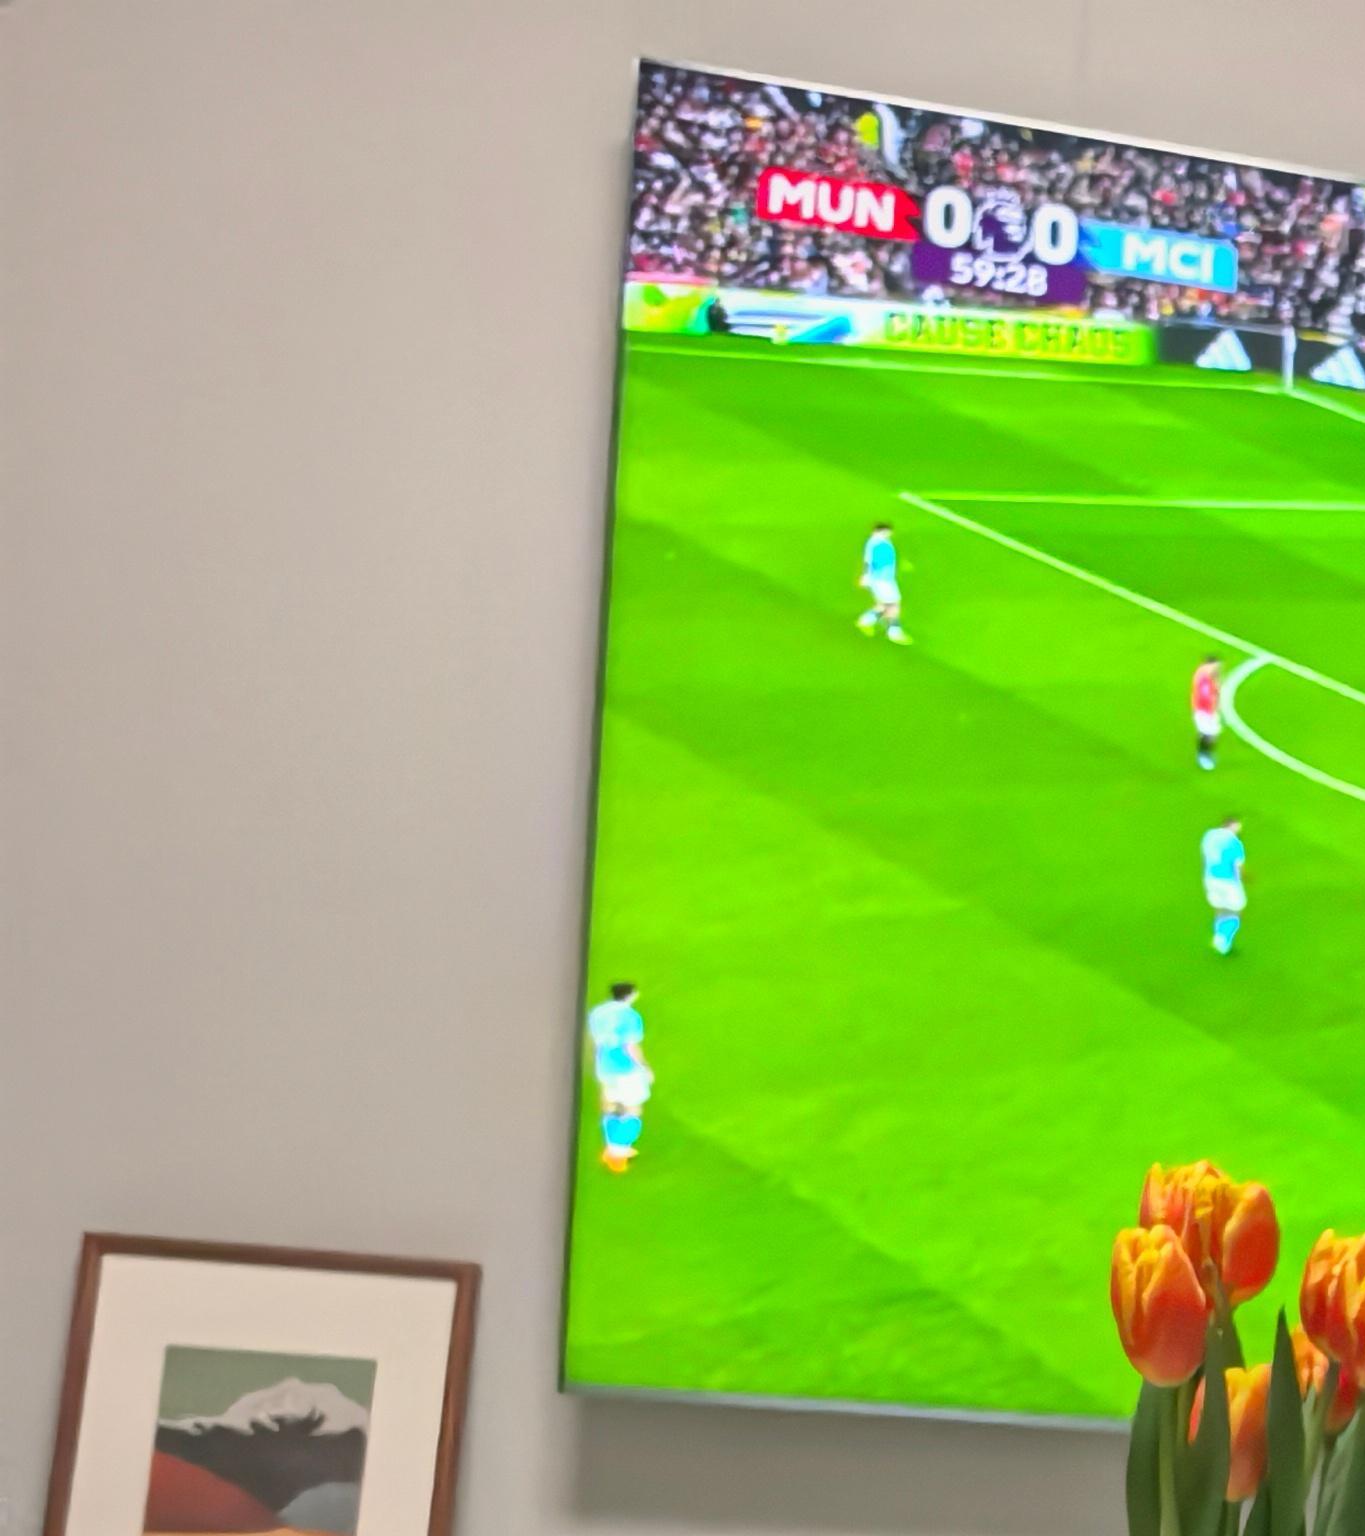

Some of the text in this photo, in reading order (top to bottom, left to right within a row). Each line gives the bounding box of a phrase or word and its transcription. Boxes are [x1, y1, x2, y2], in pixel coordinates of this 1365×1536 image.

[767, 173, 896, 232] MUN
[923, 185, 973, 248] 0
[1032, 203, 1079, 266] 0
[1122, 235, 1215, 280] MCI
[950, 252, 1048, 297] 59:28
